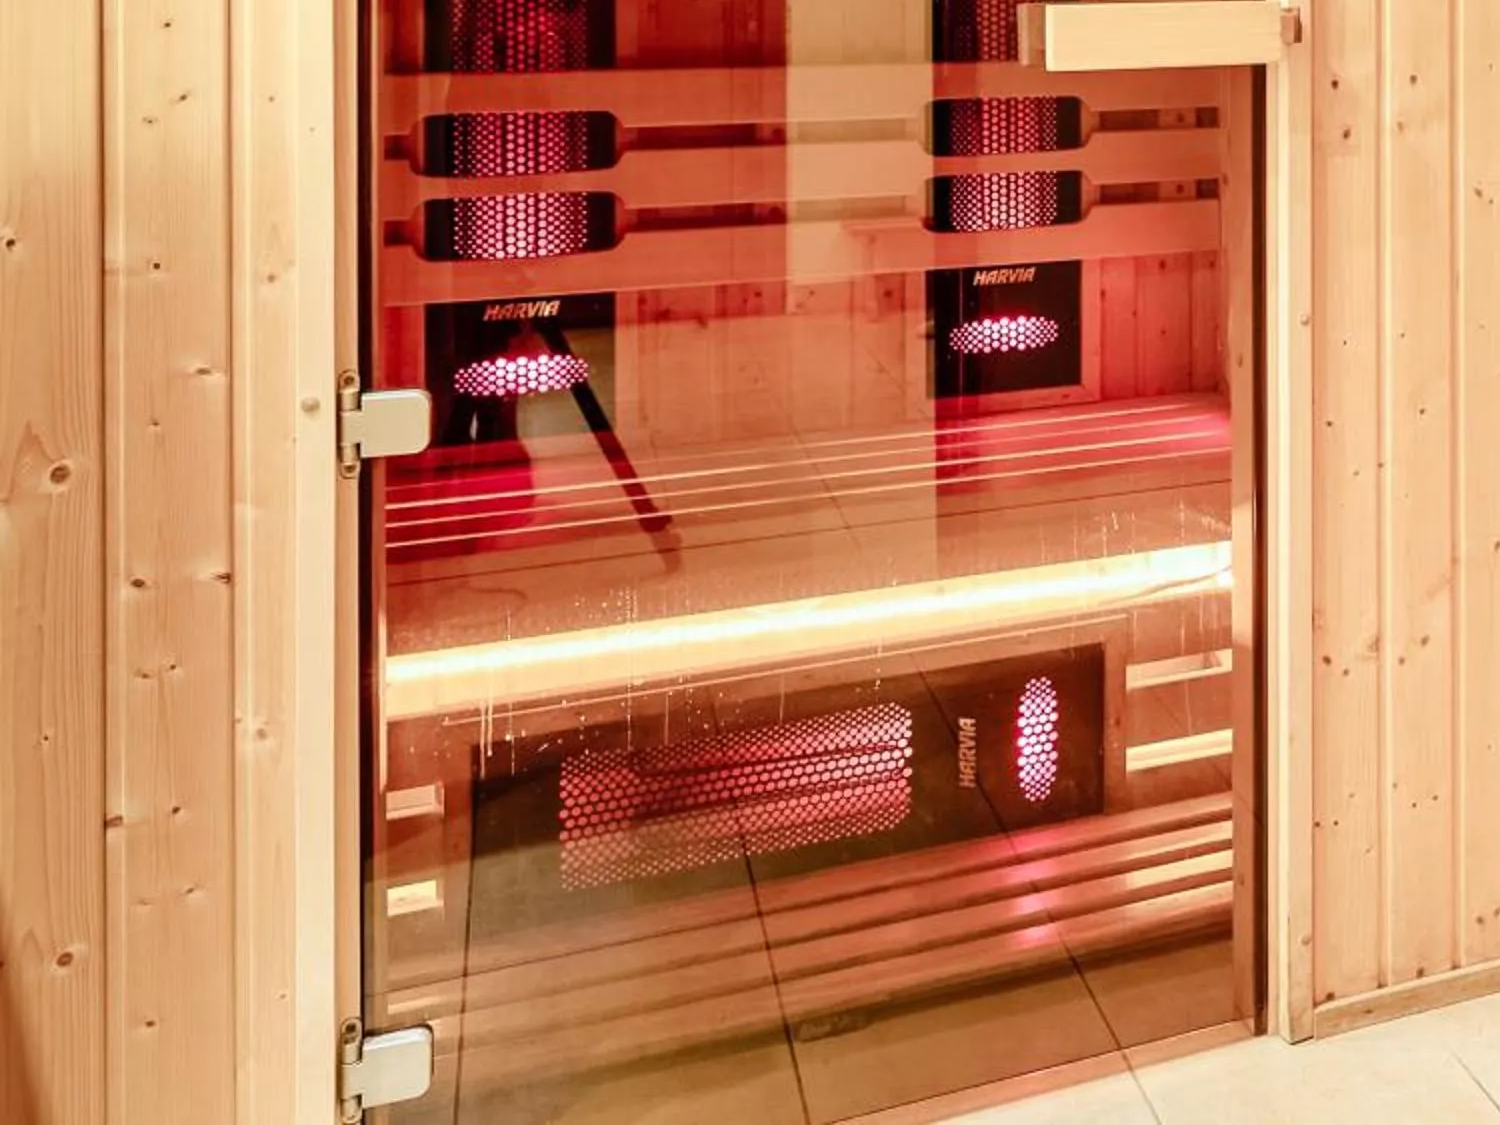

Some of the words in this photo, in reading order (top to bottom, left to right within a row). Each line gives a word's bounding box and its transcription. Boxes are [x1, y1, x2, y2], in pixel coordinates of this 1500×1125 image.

[973, 266, 1036, 286] HARVIA
[482, 300, 561, 321] HARVIA
[958, 717, 977, 788] HARVIA
